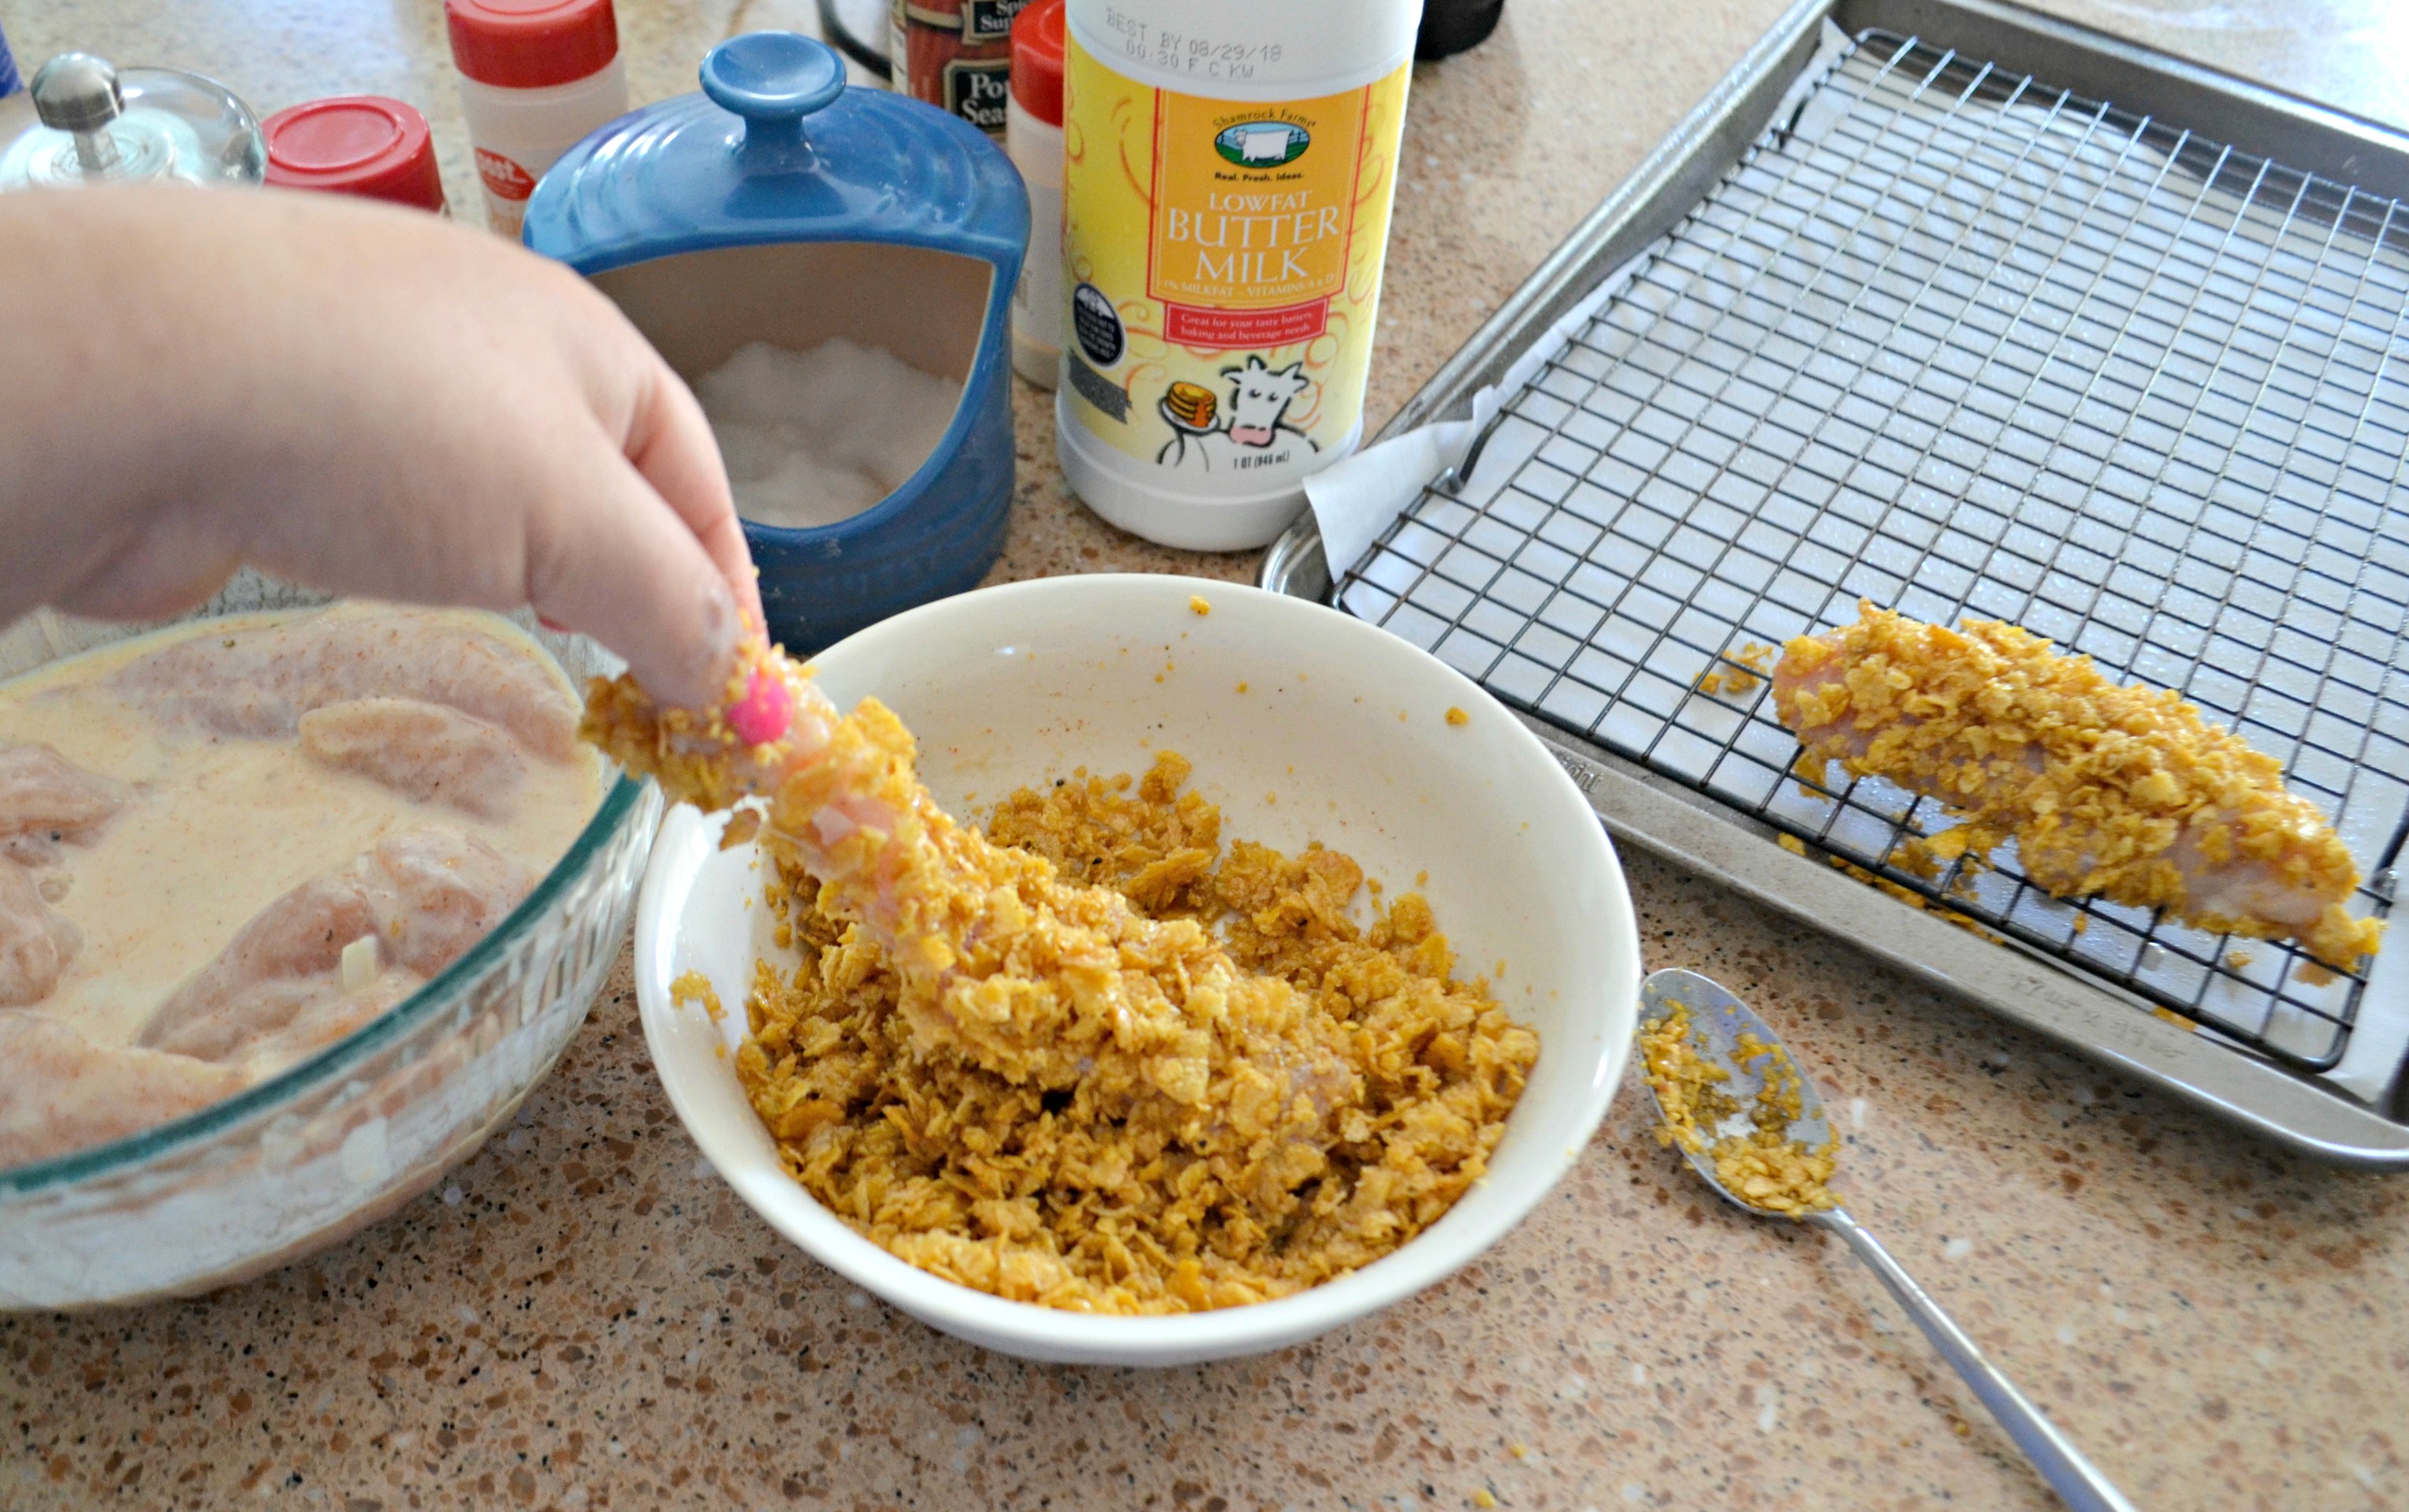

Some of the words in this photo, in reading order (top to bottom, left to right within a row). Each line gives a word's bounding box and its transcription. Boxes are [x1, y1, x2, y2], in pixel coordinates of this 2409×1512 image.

[1106, 8, 1147, 41] BEST
[1160, 32, 1181, 50] BY
[1190, 39, 1282, 62] 08/29/18
[1189, 58, 1199, 73] F
[1209, 61, 1219, 76] C
[1230, 64, 1254, 78] KW
[1213, 108, 1275, 128] Shamrock
[1210, 189, 1312, 212] LOWFAT
[1168, 206, 1339, 249] BUTTER
[1195, 247, 1309, 284] MILK
[1182, 283, 1234, 297] MILKFAT
[1247, 282, 1305, 298] VITAMINS
[1181, 312, 1209, 326] Great
[1212, 315, 1227, 327] for
[1230, 318, 1253, 330] your
[1257, 317, 1279, 328] tasty
[1181, 325, 1215, 341] baking
[1218, 328, 1236, 340] and
[1239, 327, 1282, 341] beverage
[1241, 456, 1251, 469] QT
